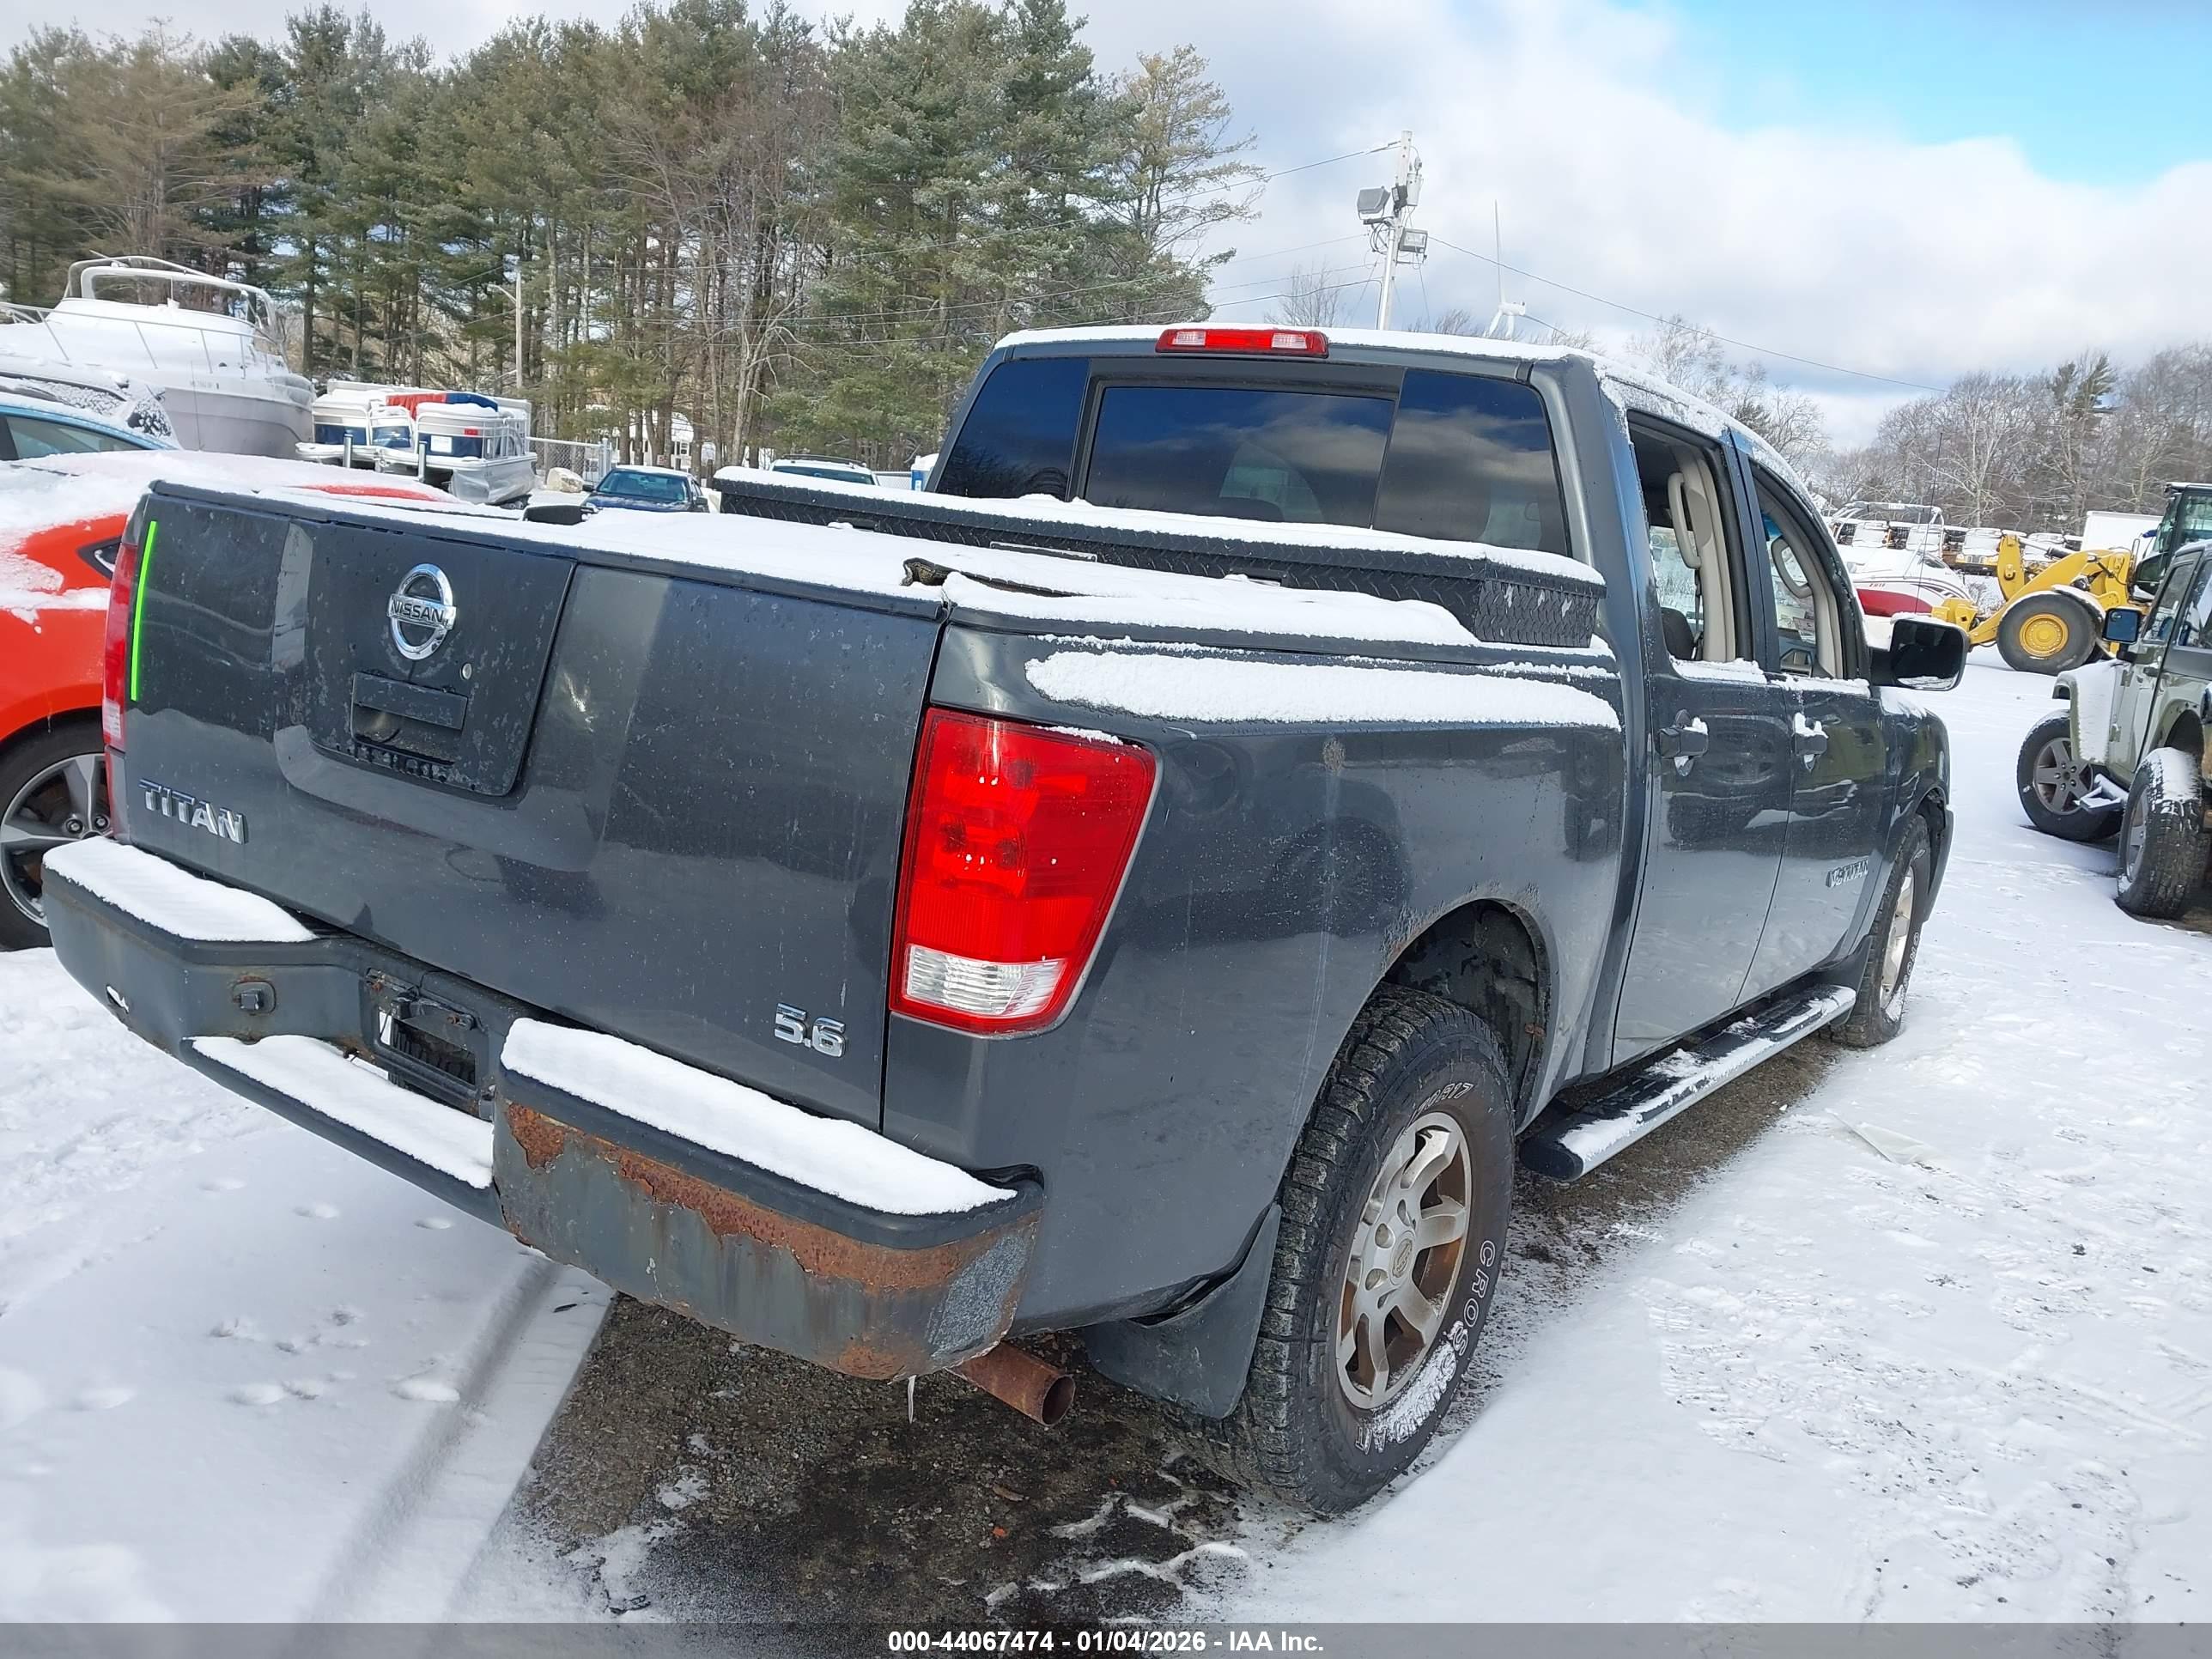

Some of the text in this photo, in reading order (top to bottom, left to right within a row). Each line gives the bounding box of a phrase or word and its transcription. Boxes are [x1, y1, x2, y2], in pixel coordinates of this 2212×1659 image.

[391, 599, 445, 623] NISSAN
[137, 779, 247, 845] TITAN
[775, 1002, 845, 1058] 5.6
